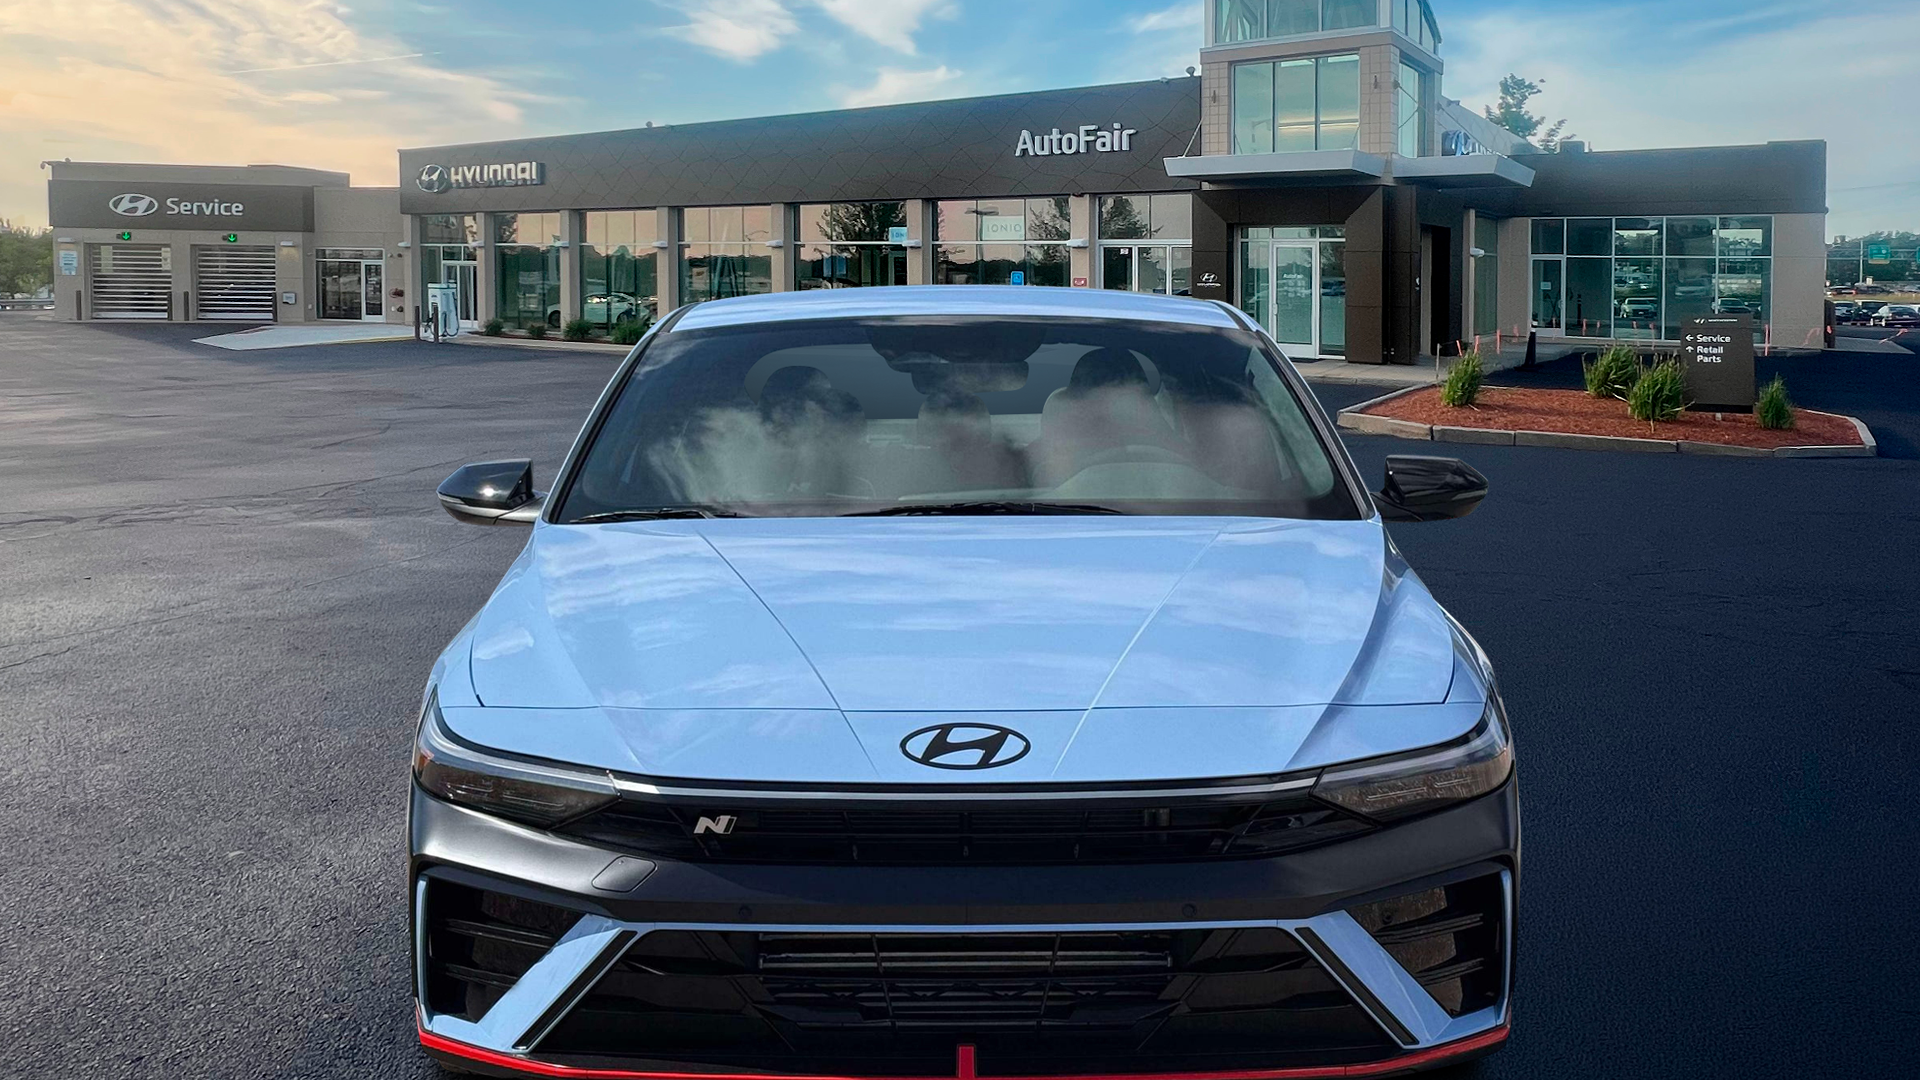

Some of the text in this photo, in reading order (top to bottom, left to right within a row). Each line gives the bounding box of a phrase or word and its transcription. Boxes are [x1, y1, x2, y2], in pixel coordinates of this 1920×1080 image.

[1015, 123, 1136, 156] AutoFair
[450, 161, 540, 188] HYUNDAI
[166, 197, 244, 216] Service
[1696, 334, 1731, 343] Service
[1696, 345, 1724, 354] Retail
[1697, 355, 1722, 363] Parts
